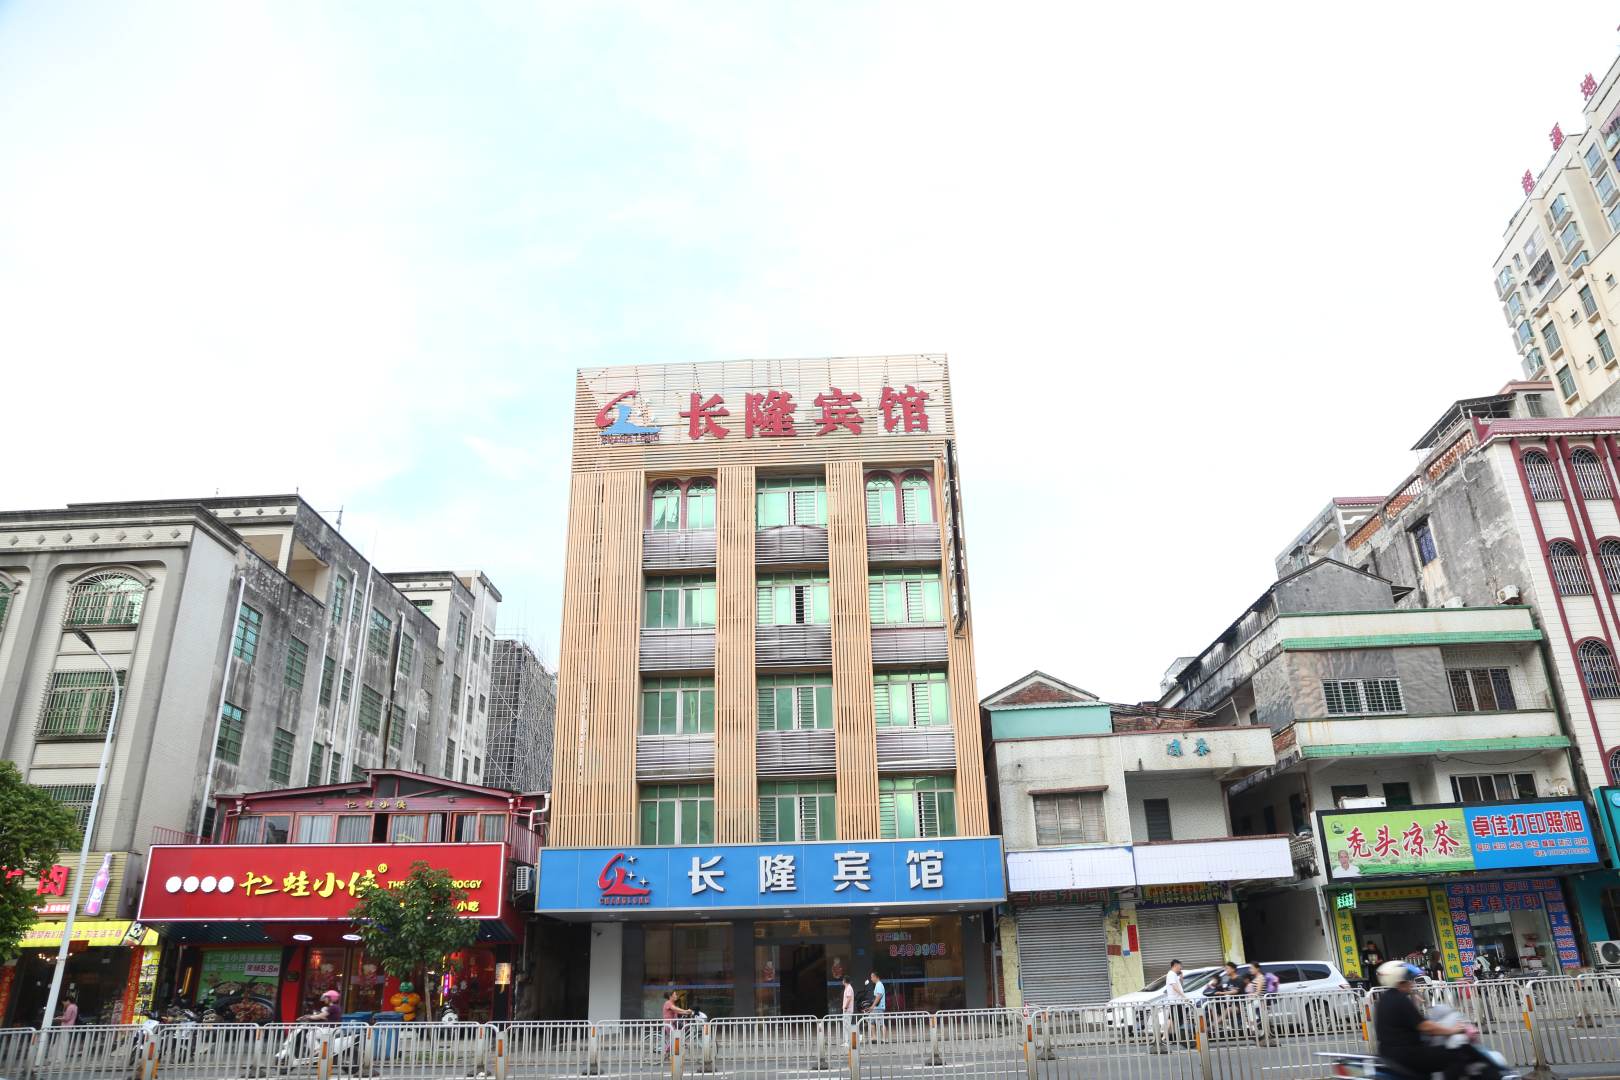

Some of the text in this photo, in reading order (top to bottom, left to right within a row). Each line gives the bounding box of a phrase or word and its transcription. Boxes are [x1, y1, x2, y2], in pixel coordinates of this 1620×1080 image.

[679, 384, 930, 440] 长隆宾馆
[1346, 819, 1460, 858] 秃头凉茶
[1472, 811, 1583, 837] 卓佳打印照相
[688, 849, 944, 894] 长隆宾馆
